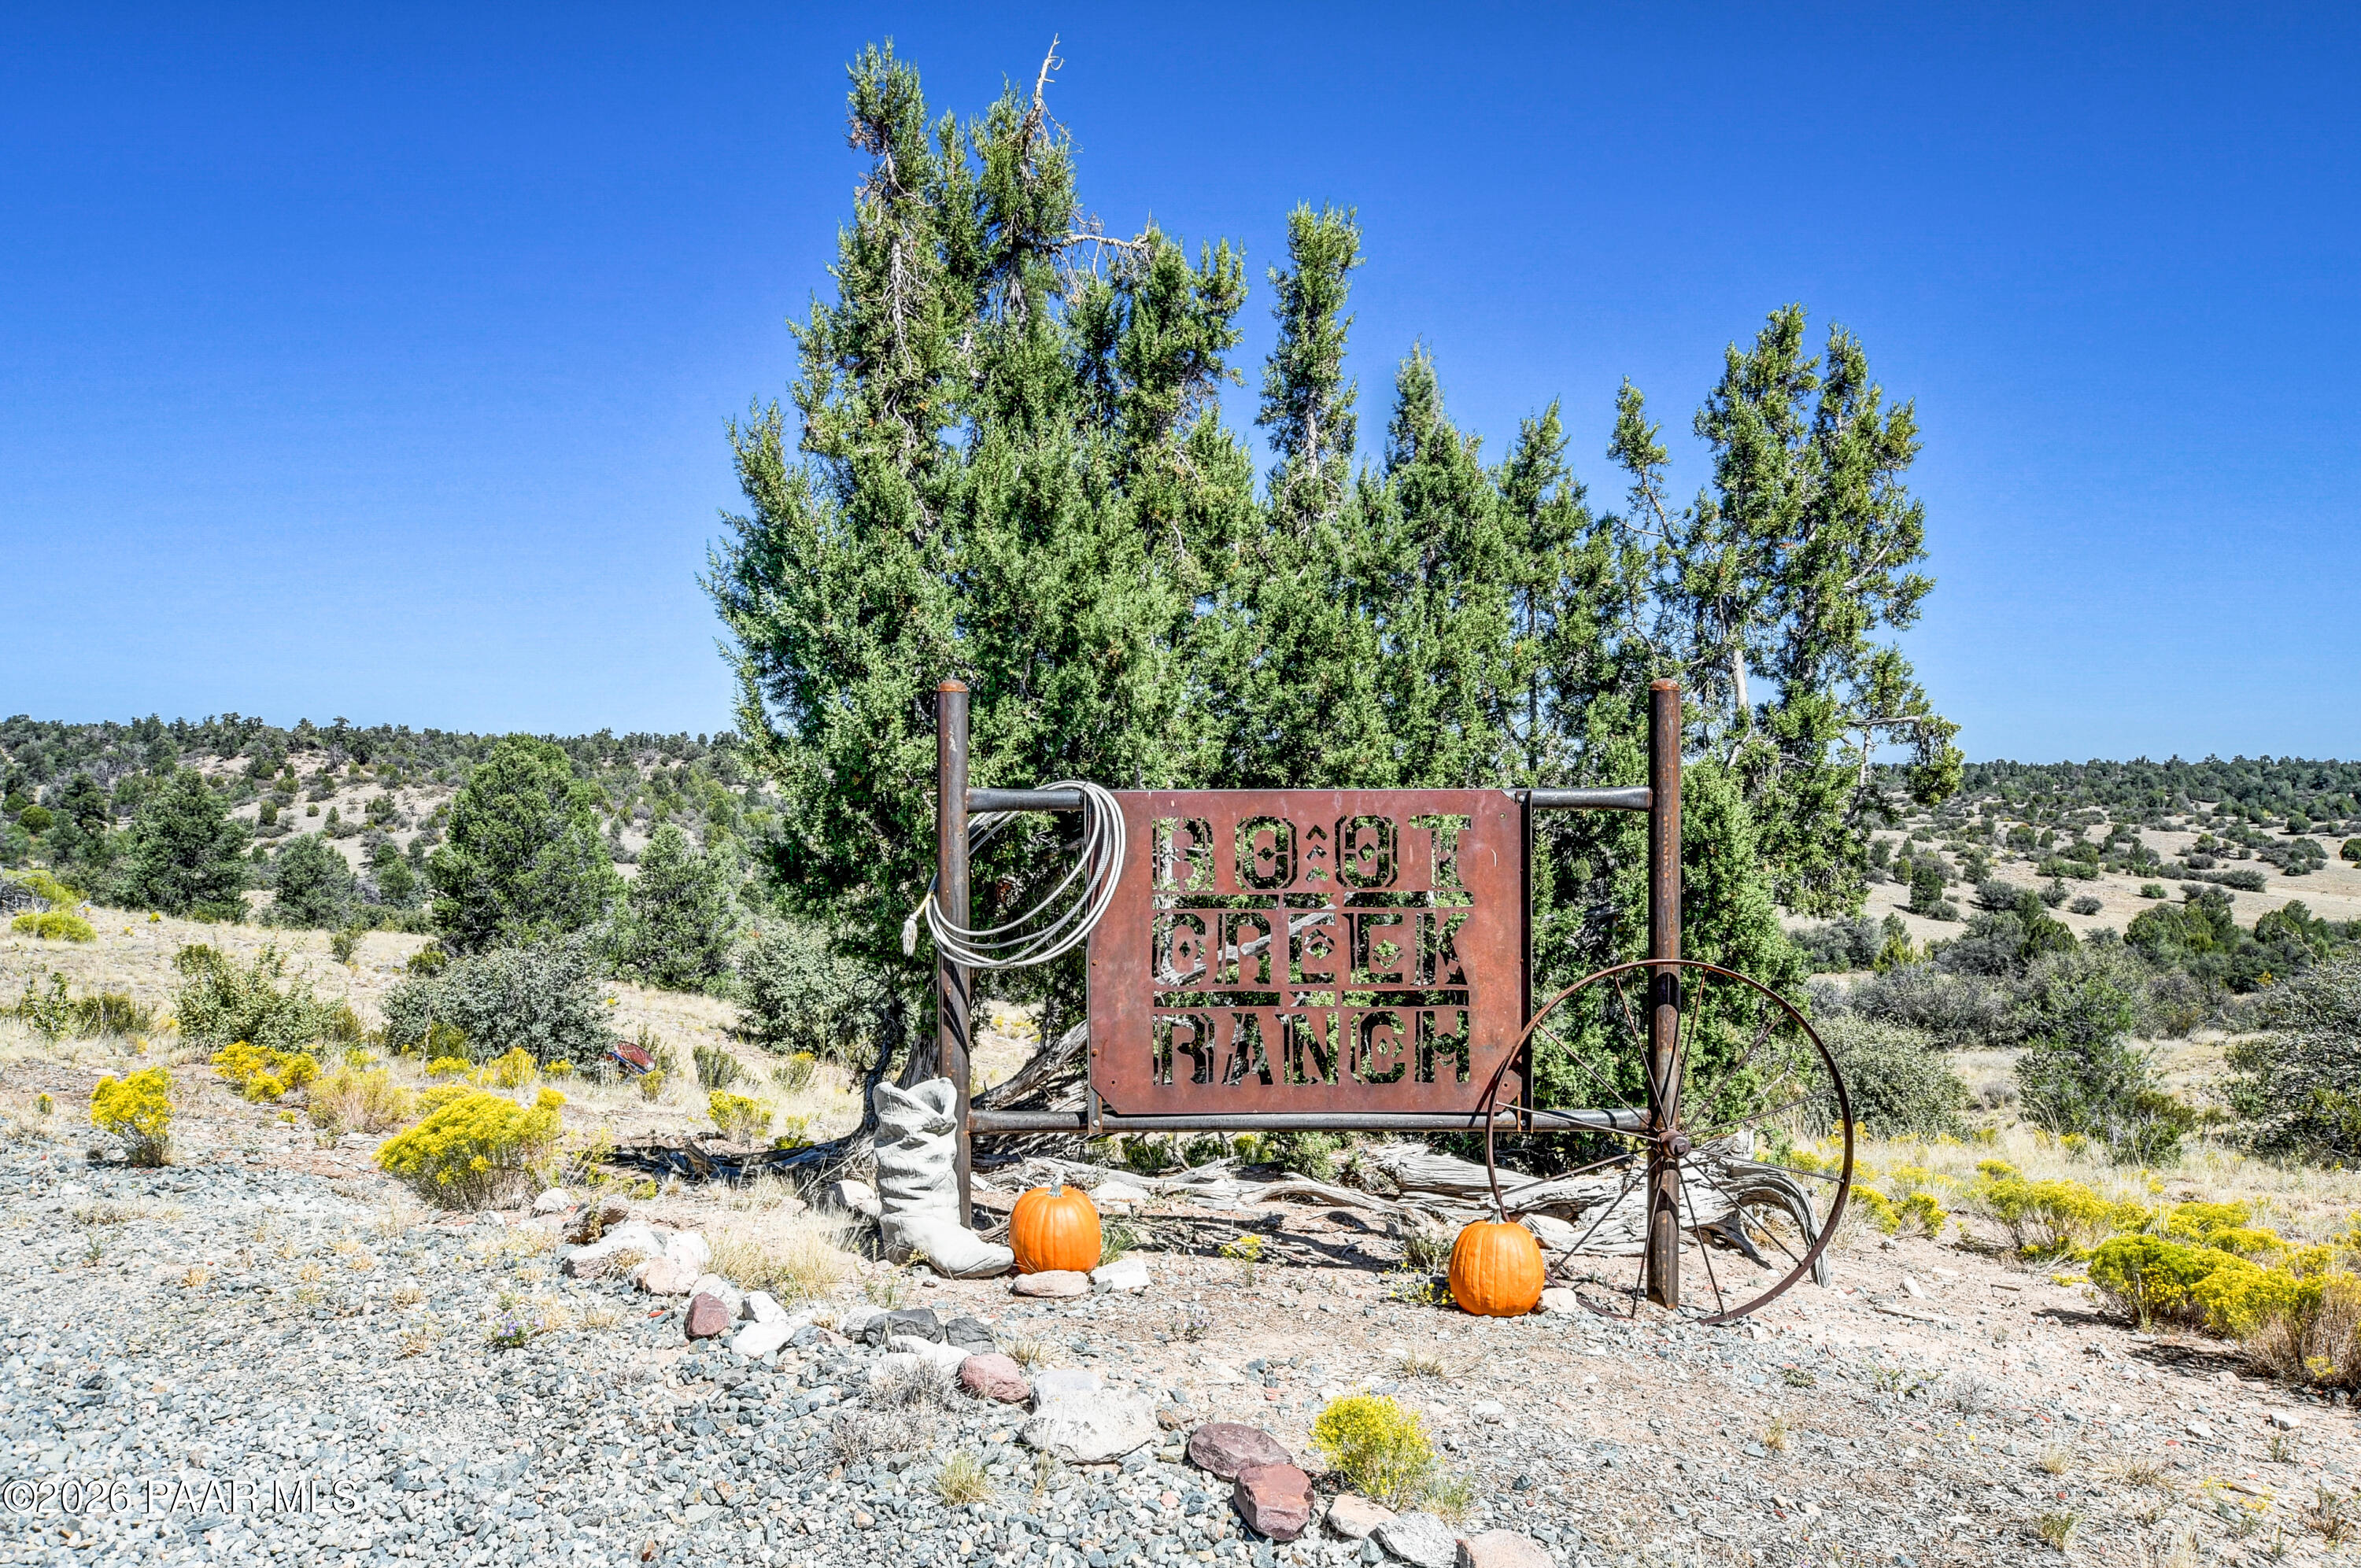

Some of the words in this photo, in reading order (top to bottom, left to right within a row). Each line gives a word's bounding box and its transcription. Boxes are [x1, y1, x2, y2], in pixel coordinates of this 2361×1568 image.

[1151, 814, 1472, 892] BOOT
[1151, 912, 1469, 986] CREEK
[1152, 1010, 1471, 1087] RANCH
